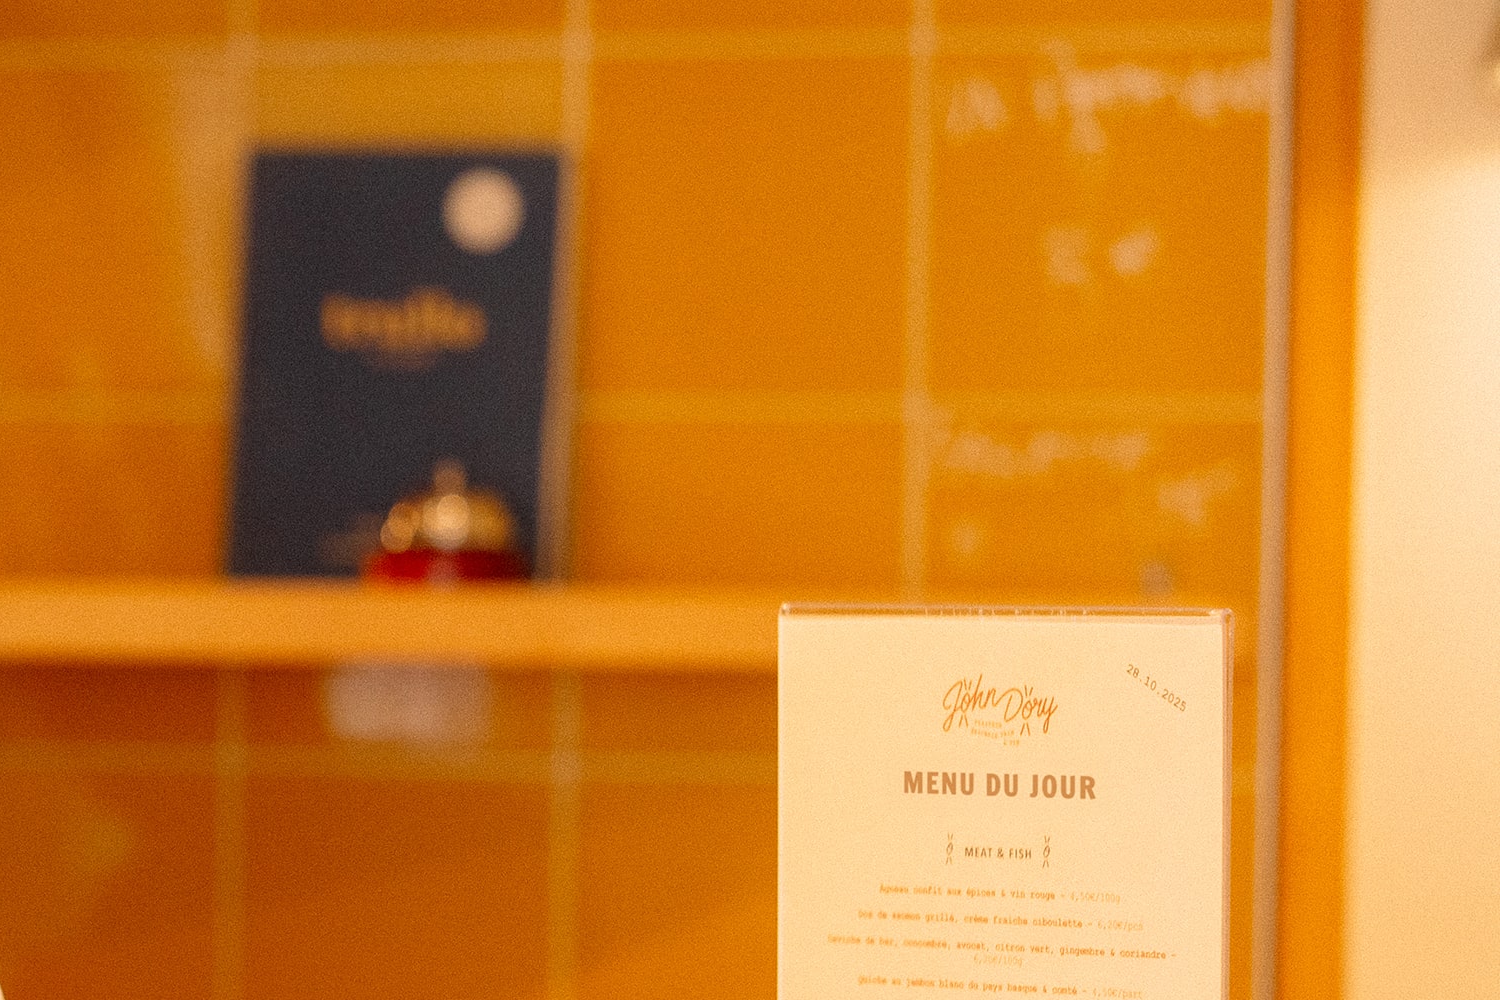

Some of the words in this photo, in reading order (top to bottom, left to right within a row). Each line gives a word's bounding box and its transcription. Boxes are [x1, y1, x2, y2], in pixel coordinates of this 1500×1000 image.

[1127, 664, 1187, 712] 28.10.2025
[943, 674, 999, 732] John
[1000, 686, 1059, 734] Dory
[904, 771, 975, 796] MENU
[986, 773, 1019, 798] DU
[1029, 775, 1097, 800] JOUR
[964, 846, 993, 859] MEAT
[997, 847, 1005, 859] &
[1008, 848, 1033, 860] FISH
[1060, 944, 1105, 958] gingembre
